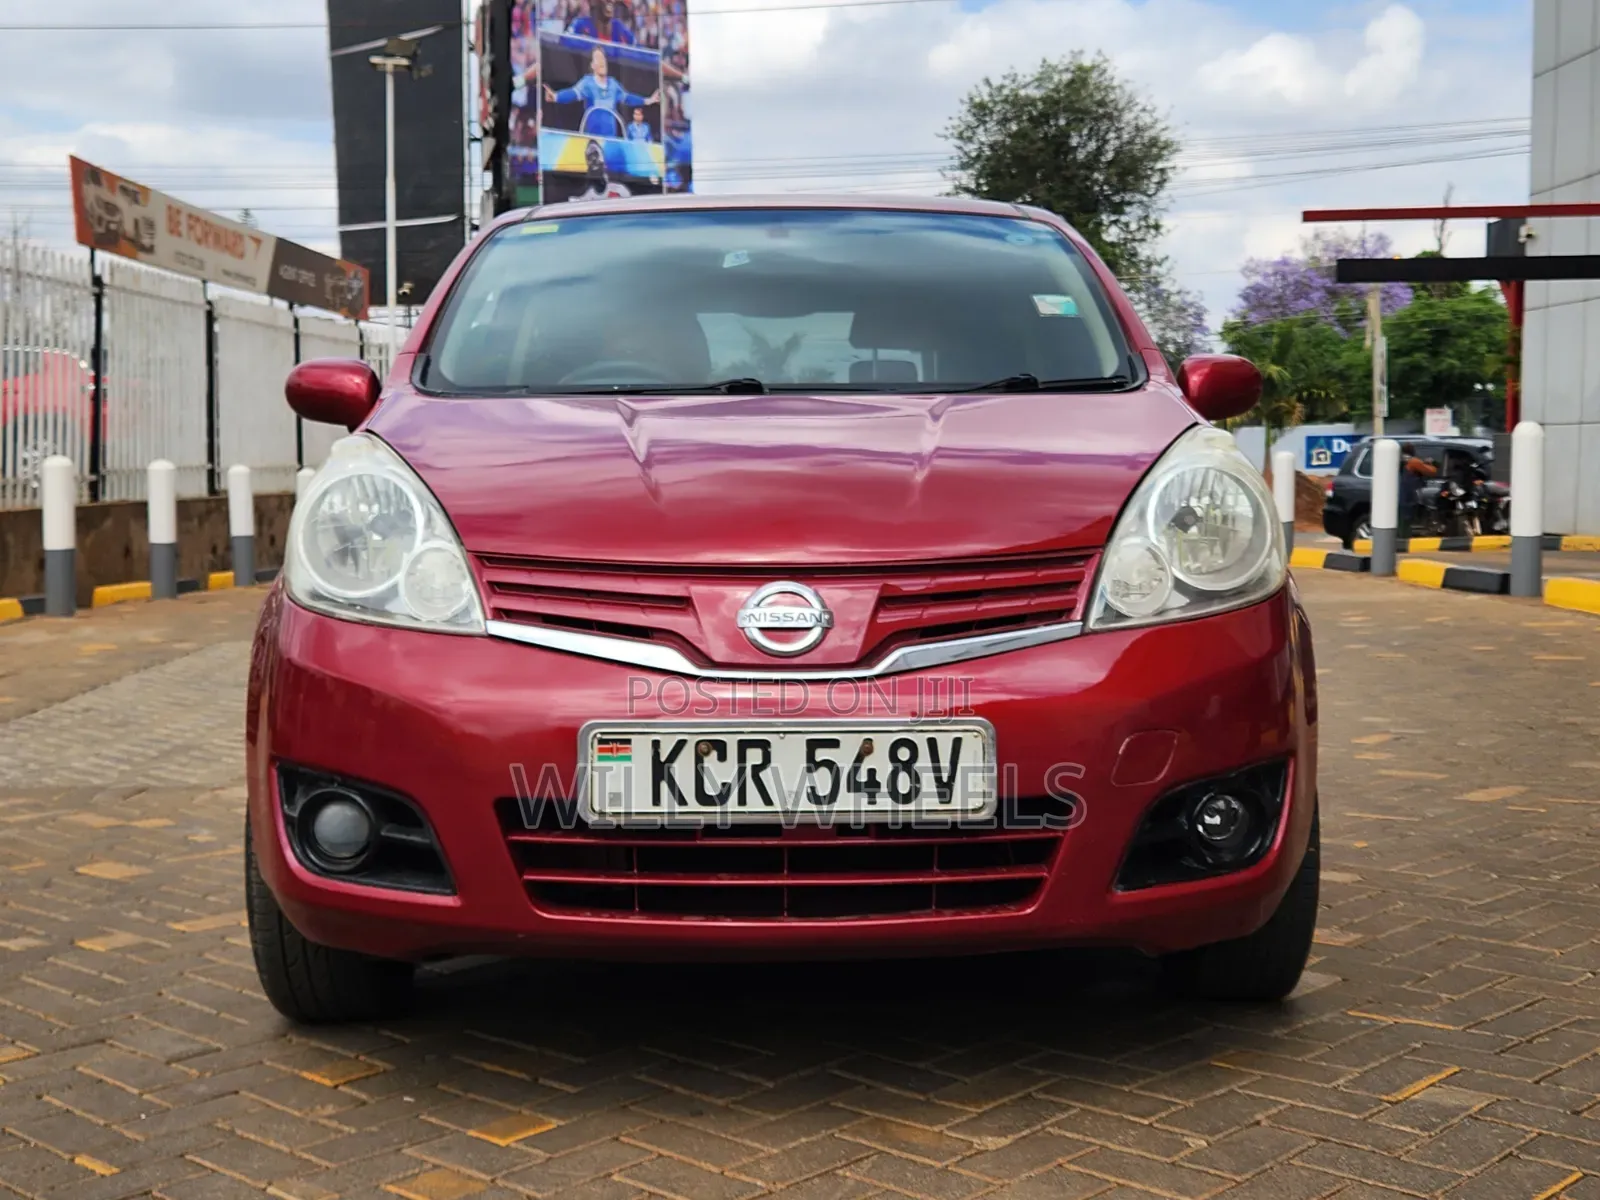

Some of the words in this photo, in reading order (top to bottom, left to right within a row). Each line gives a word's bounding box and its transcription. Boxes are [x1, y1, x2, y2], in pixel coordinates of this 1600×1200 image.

[747, 611, 823, 624] NISSAN
[651, 738, 775, 807] KCR
[806, 737, 963, 805] 548V
